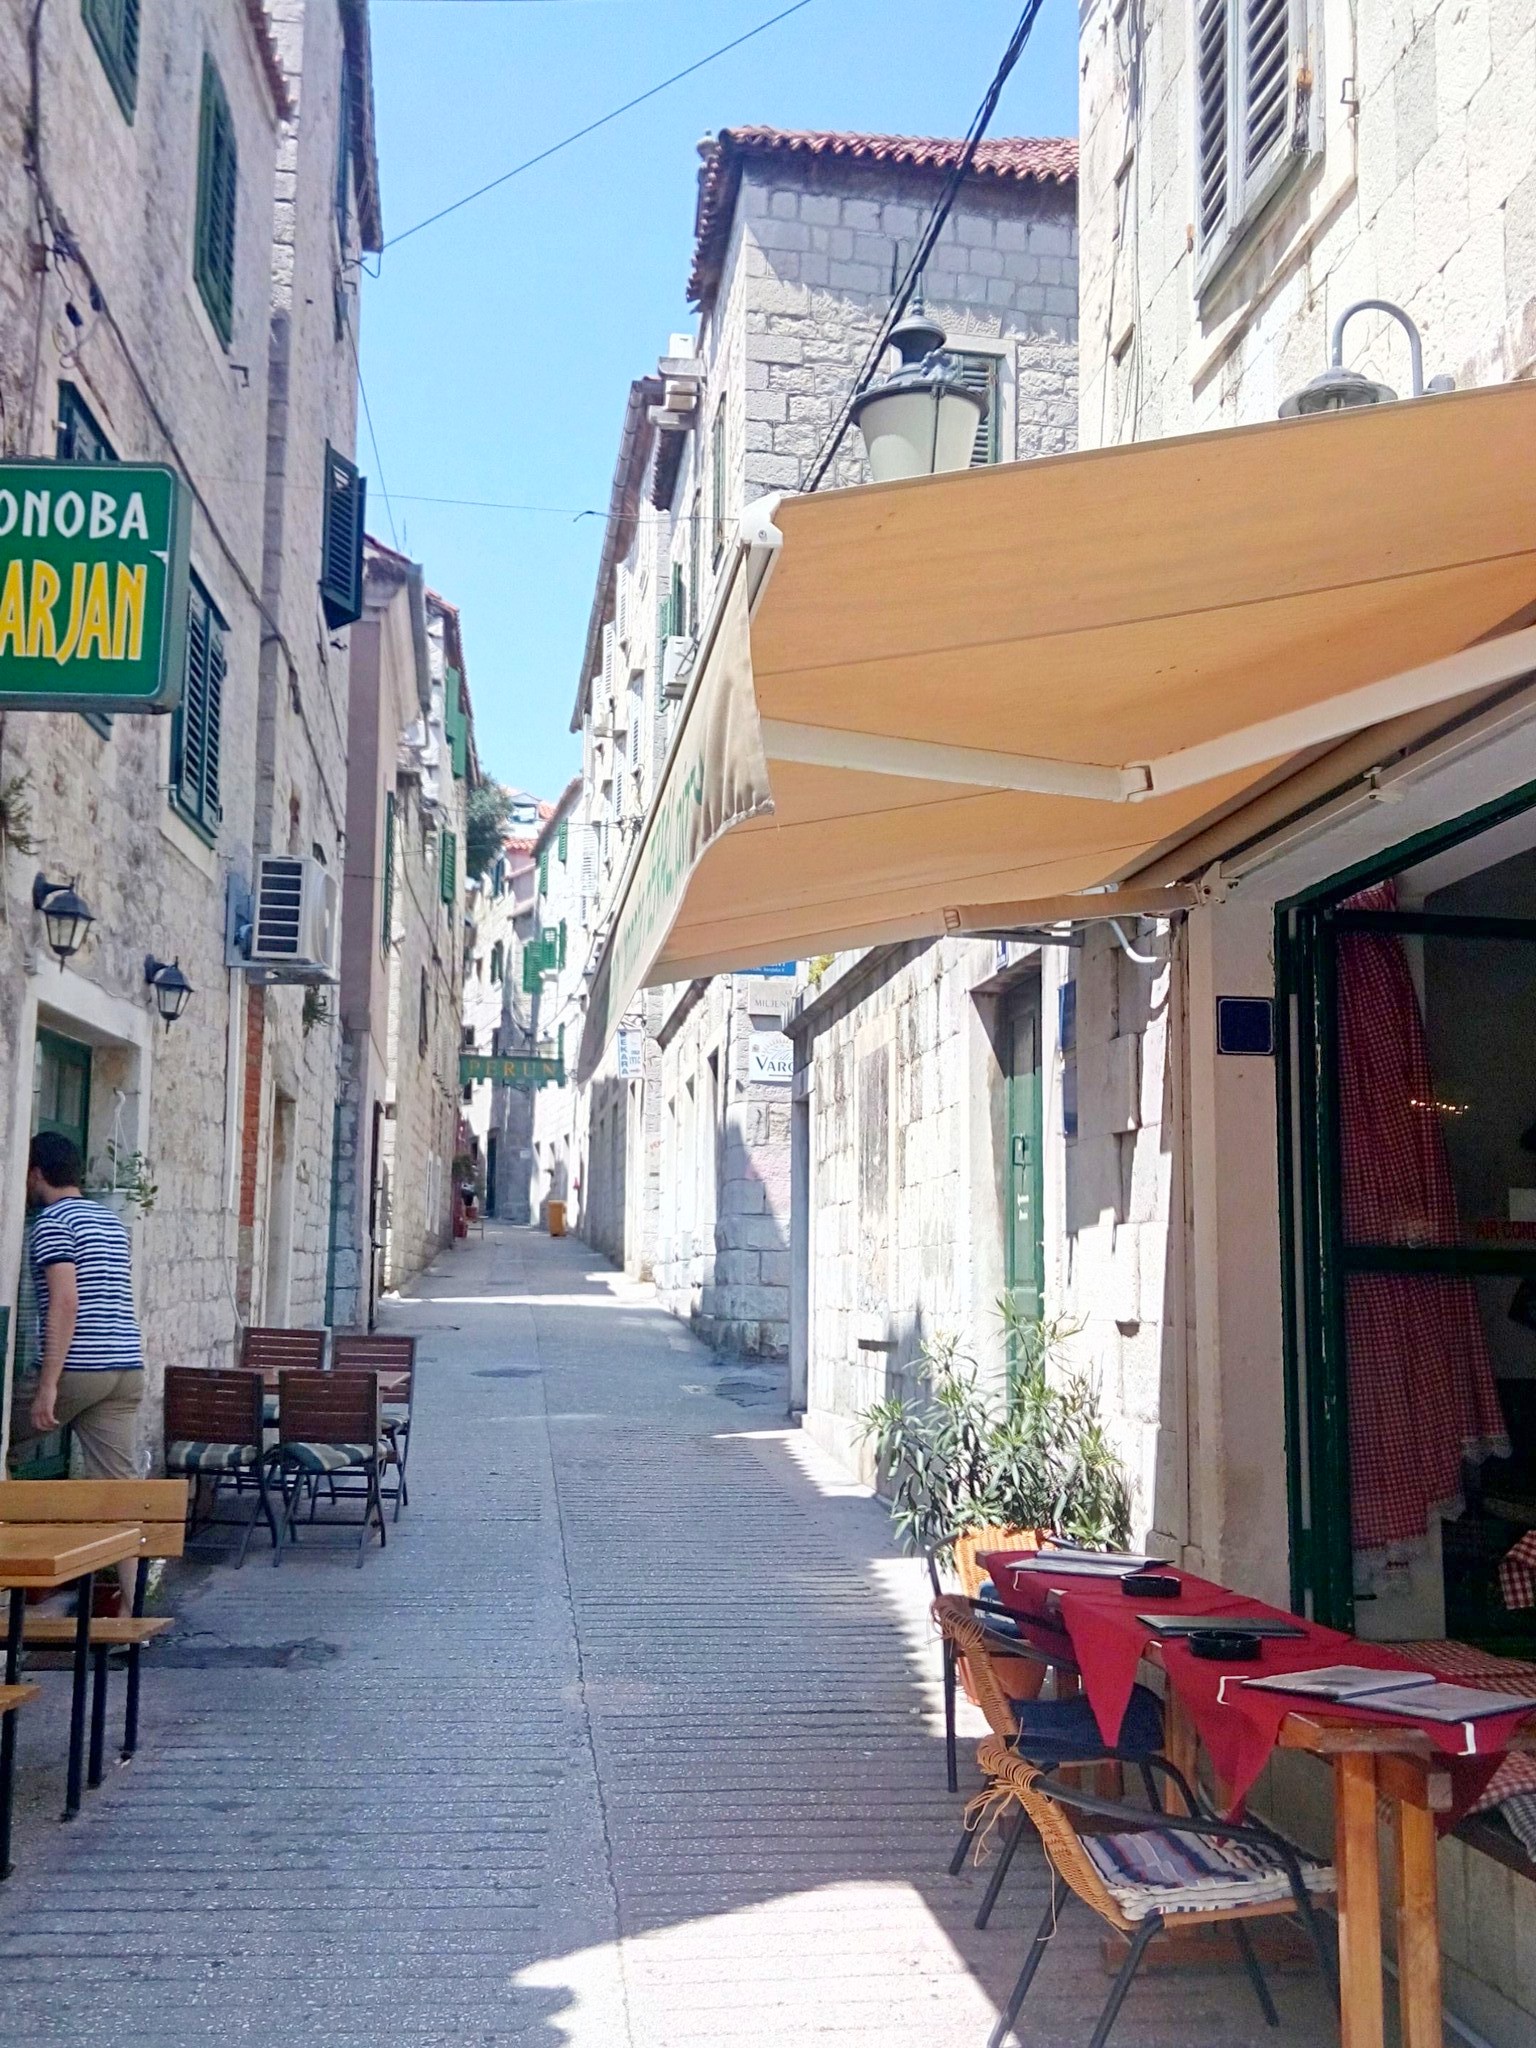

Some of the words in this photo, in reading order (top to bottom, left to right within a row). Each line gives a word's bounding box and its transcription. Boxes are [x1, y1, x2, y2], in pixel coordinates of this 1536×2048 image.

[0, 489, 149, 540] ONOBA
[0, 559, 148, 666] ARJAN
[469, 1060, 556, 1077] PERUN
